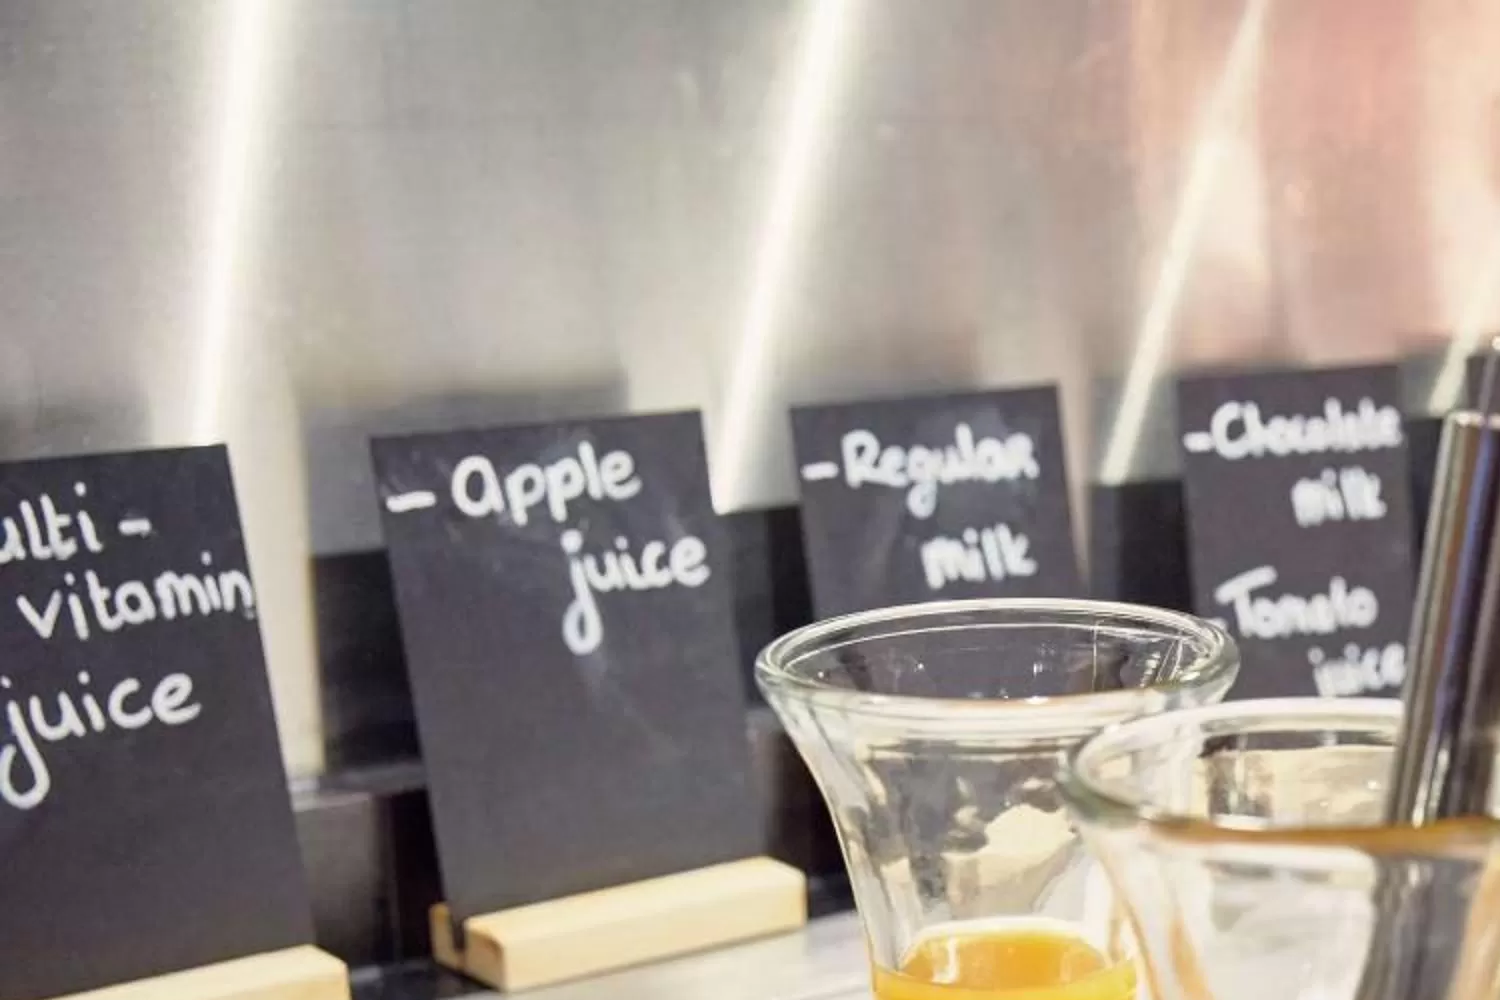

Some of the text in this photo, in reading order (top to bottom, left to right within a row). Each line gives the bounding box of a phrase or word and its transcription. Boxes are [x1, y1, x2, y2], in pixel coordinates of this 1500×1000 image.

[17, 551, 258, 640] vitamin
[560, 528, 711, 655] juice
[920, 522, 1037, 589] milk
[0, 671, 201, 809] juice
